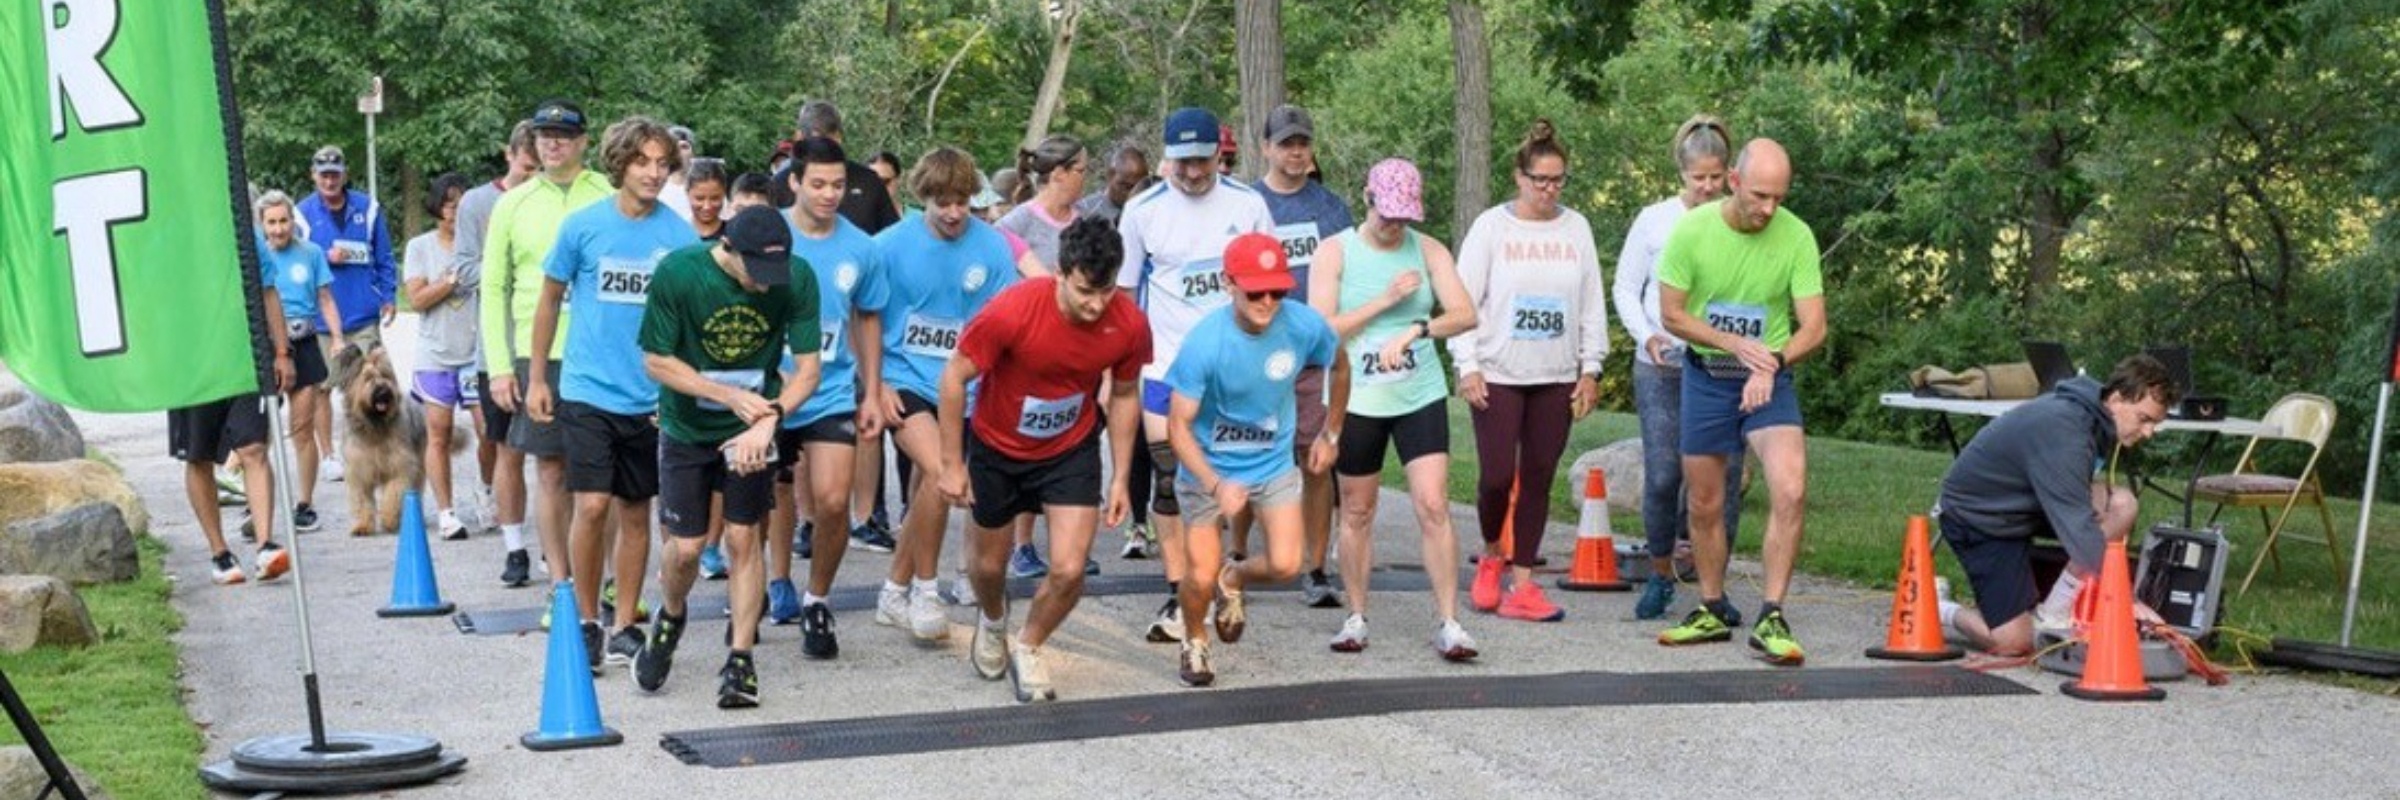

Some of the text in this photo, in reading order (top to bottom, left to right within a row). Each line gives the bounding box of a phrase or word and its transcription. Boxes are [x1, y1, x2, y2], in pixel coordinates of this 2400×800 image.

[1505, 242, 1579, 262] MAMA
[601, 270, 655, 295] 2562
[1514, 309, 1565, 332] 2538
[1709, 313, 1763, 337] 2534
[906, 325, 958, 350] 2546
[1363, 349, 1417, 375] 23
[1023, 405, 1079, 430] 2558
